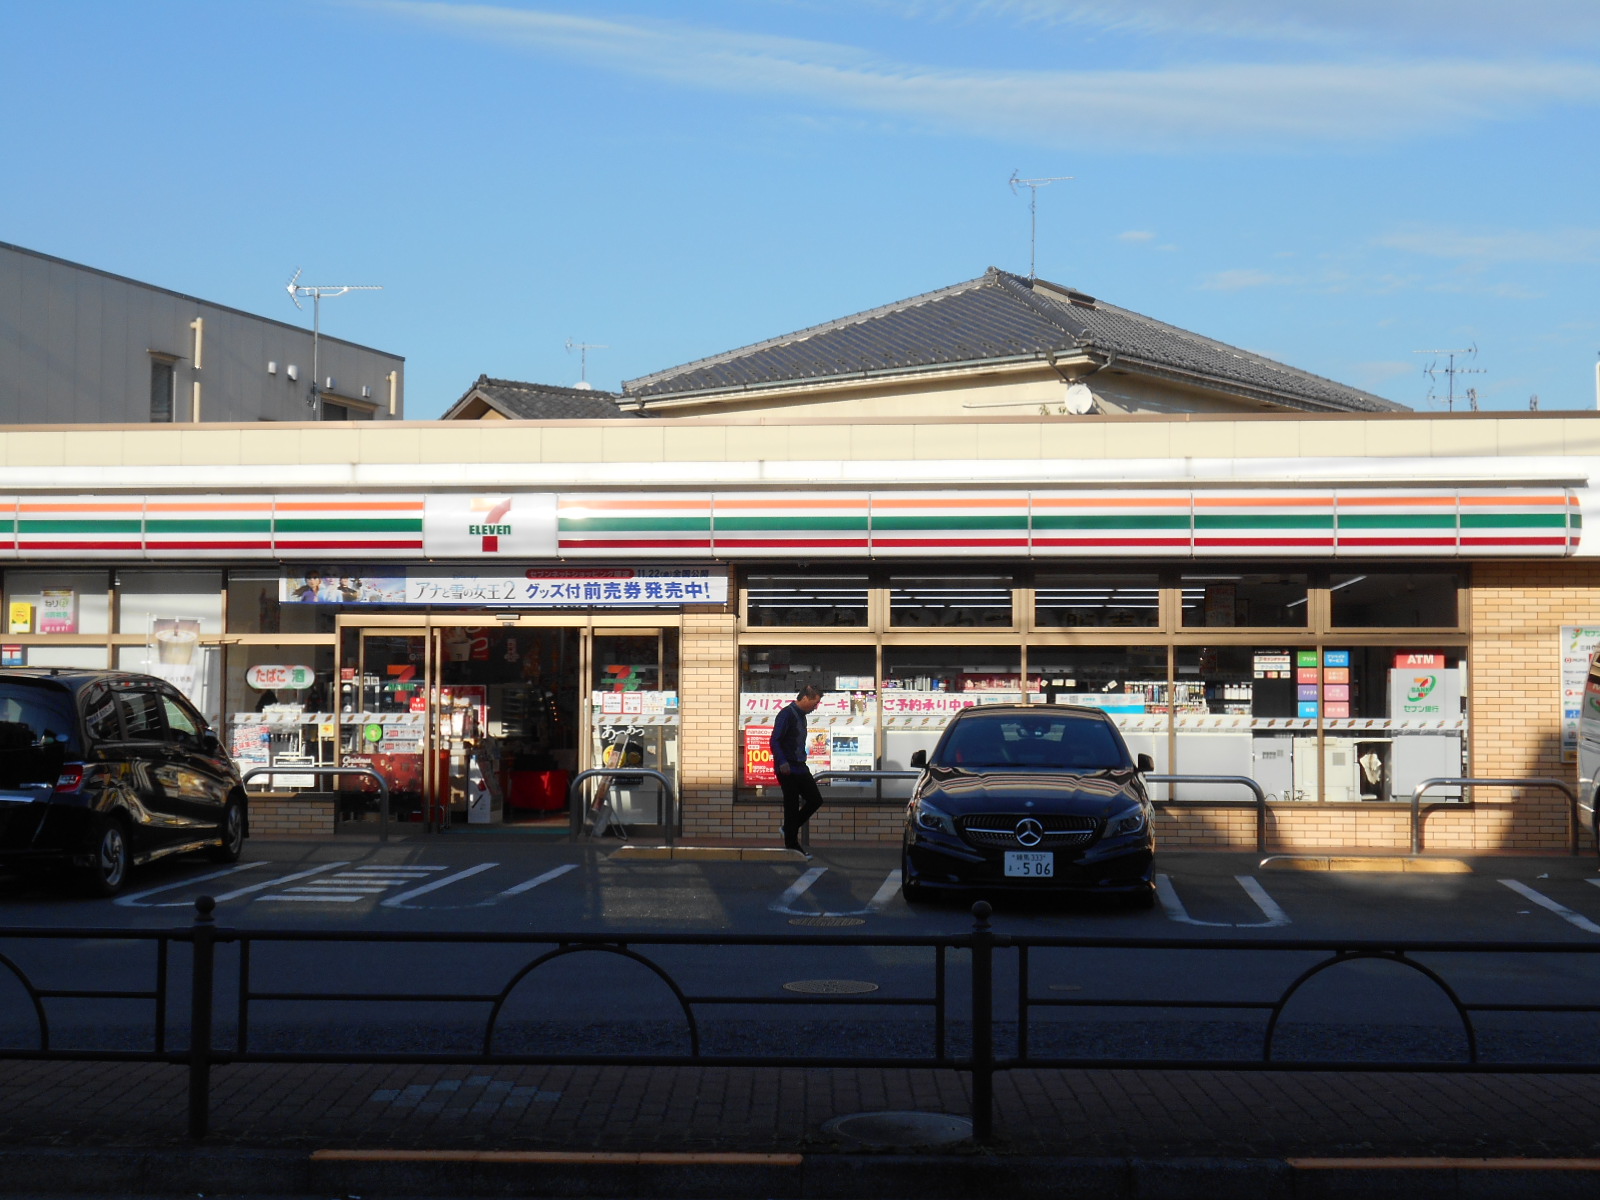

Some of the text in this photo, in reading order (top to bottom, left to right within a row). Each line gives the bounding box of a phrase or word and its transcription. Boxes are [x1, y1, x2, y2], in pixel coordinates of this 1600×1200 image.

[469, 524, 512, 535] ELEVEN
[1407, 654, 1435, 665] ATM
[255, 668, 306, 683] たばこ 酒
[883, 698, 961, 712] ご予約承り中
[1403, 705, 1440, 713] セブン銀行
